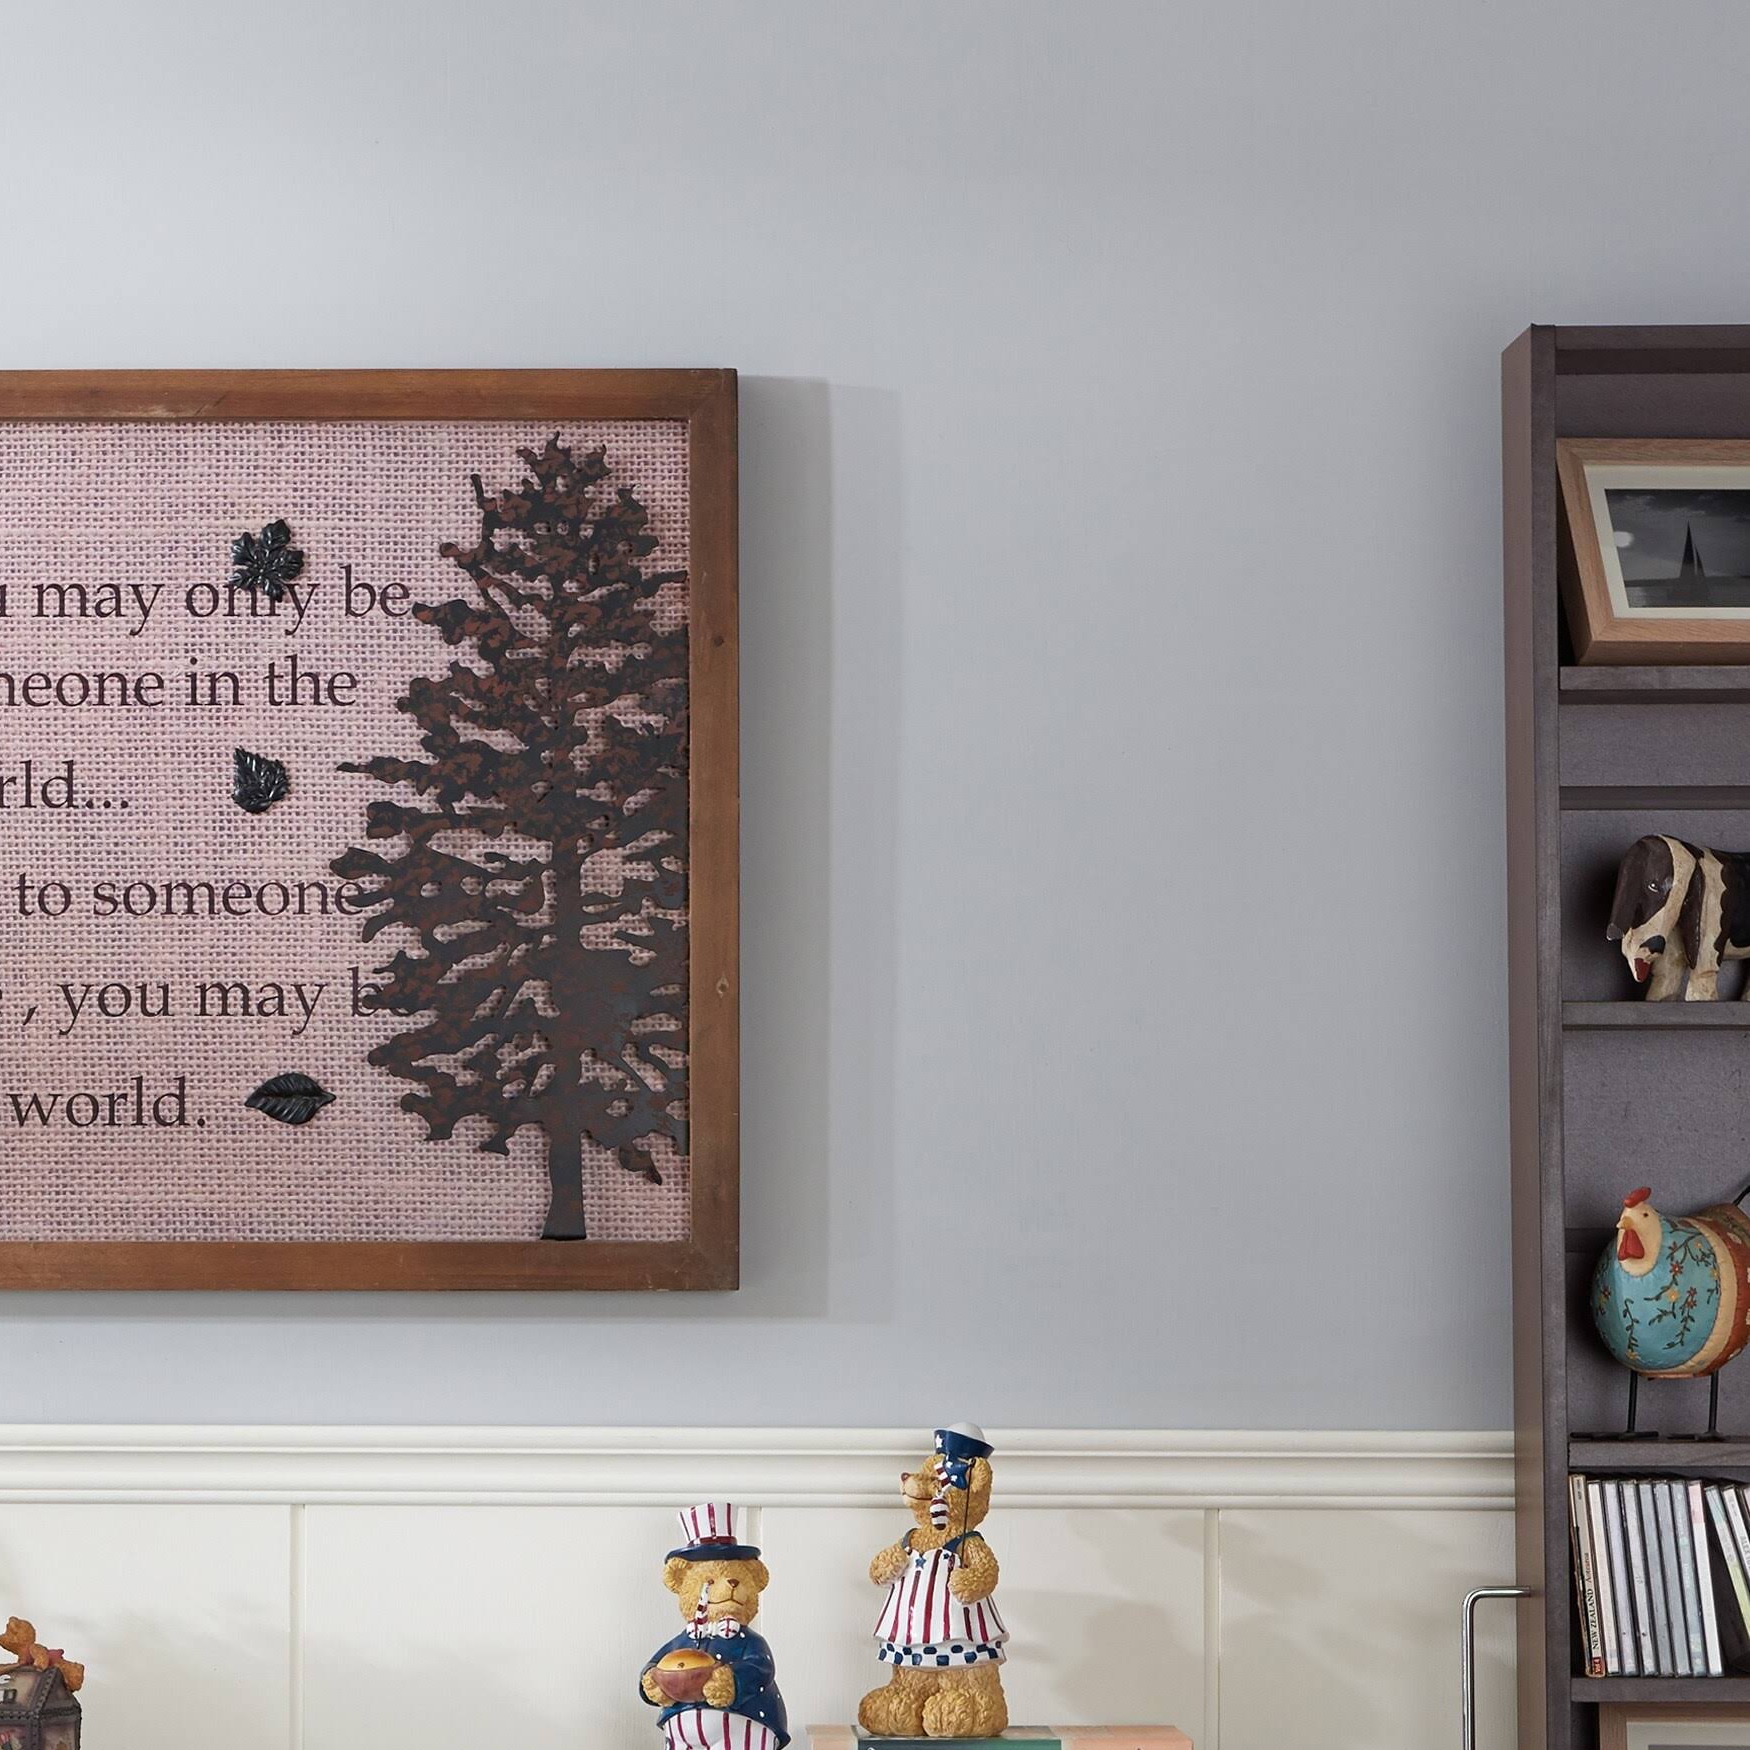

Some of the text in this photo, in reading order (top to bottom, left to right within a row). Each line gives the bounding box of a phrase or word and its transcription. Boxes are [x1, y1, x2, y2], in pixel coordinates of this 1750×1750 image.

[30, 581, 164, 636] may
[340, 564, 412, 618] be
[185, 656, 245, 707] in
[262, 653, 359, 707] the
[13, 870, 72, 918] to
[91, 880, 365, 918] someone
[58, 982, 182, 1036] you
[193, 982, 328, 1036] may
[347, 966, 418, 1018] b
[2, 1075, 207, 1128] world.
[1586, 1588, 1599, 1629] ZEALAND
[1591, 1630, 1601, 1650] NEW
